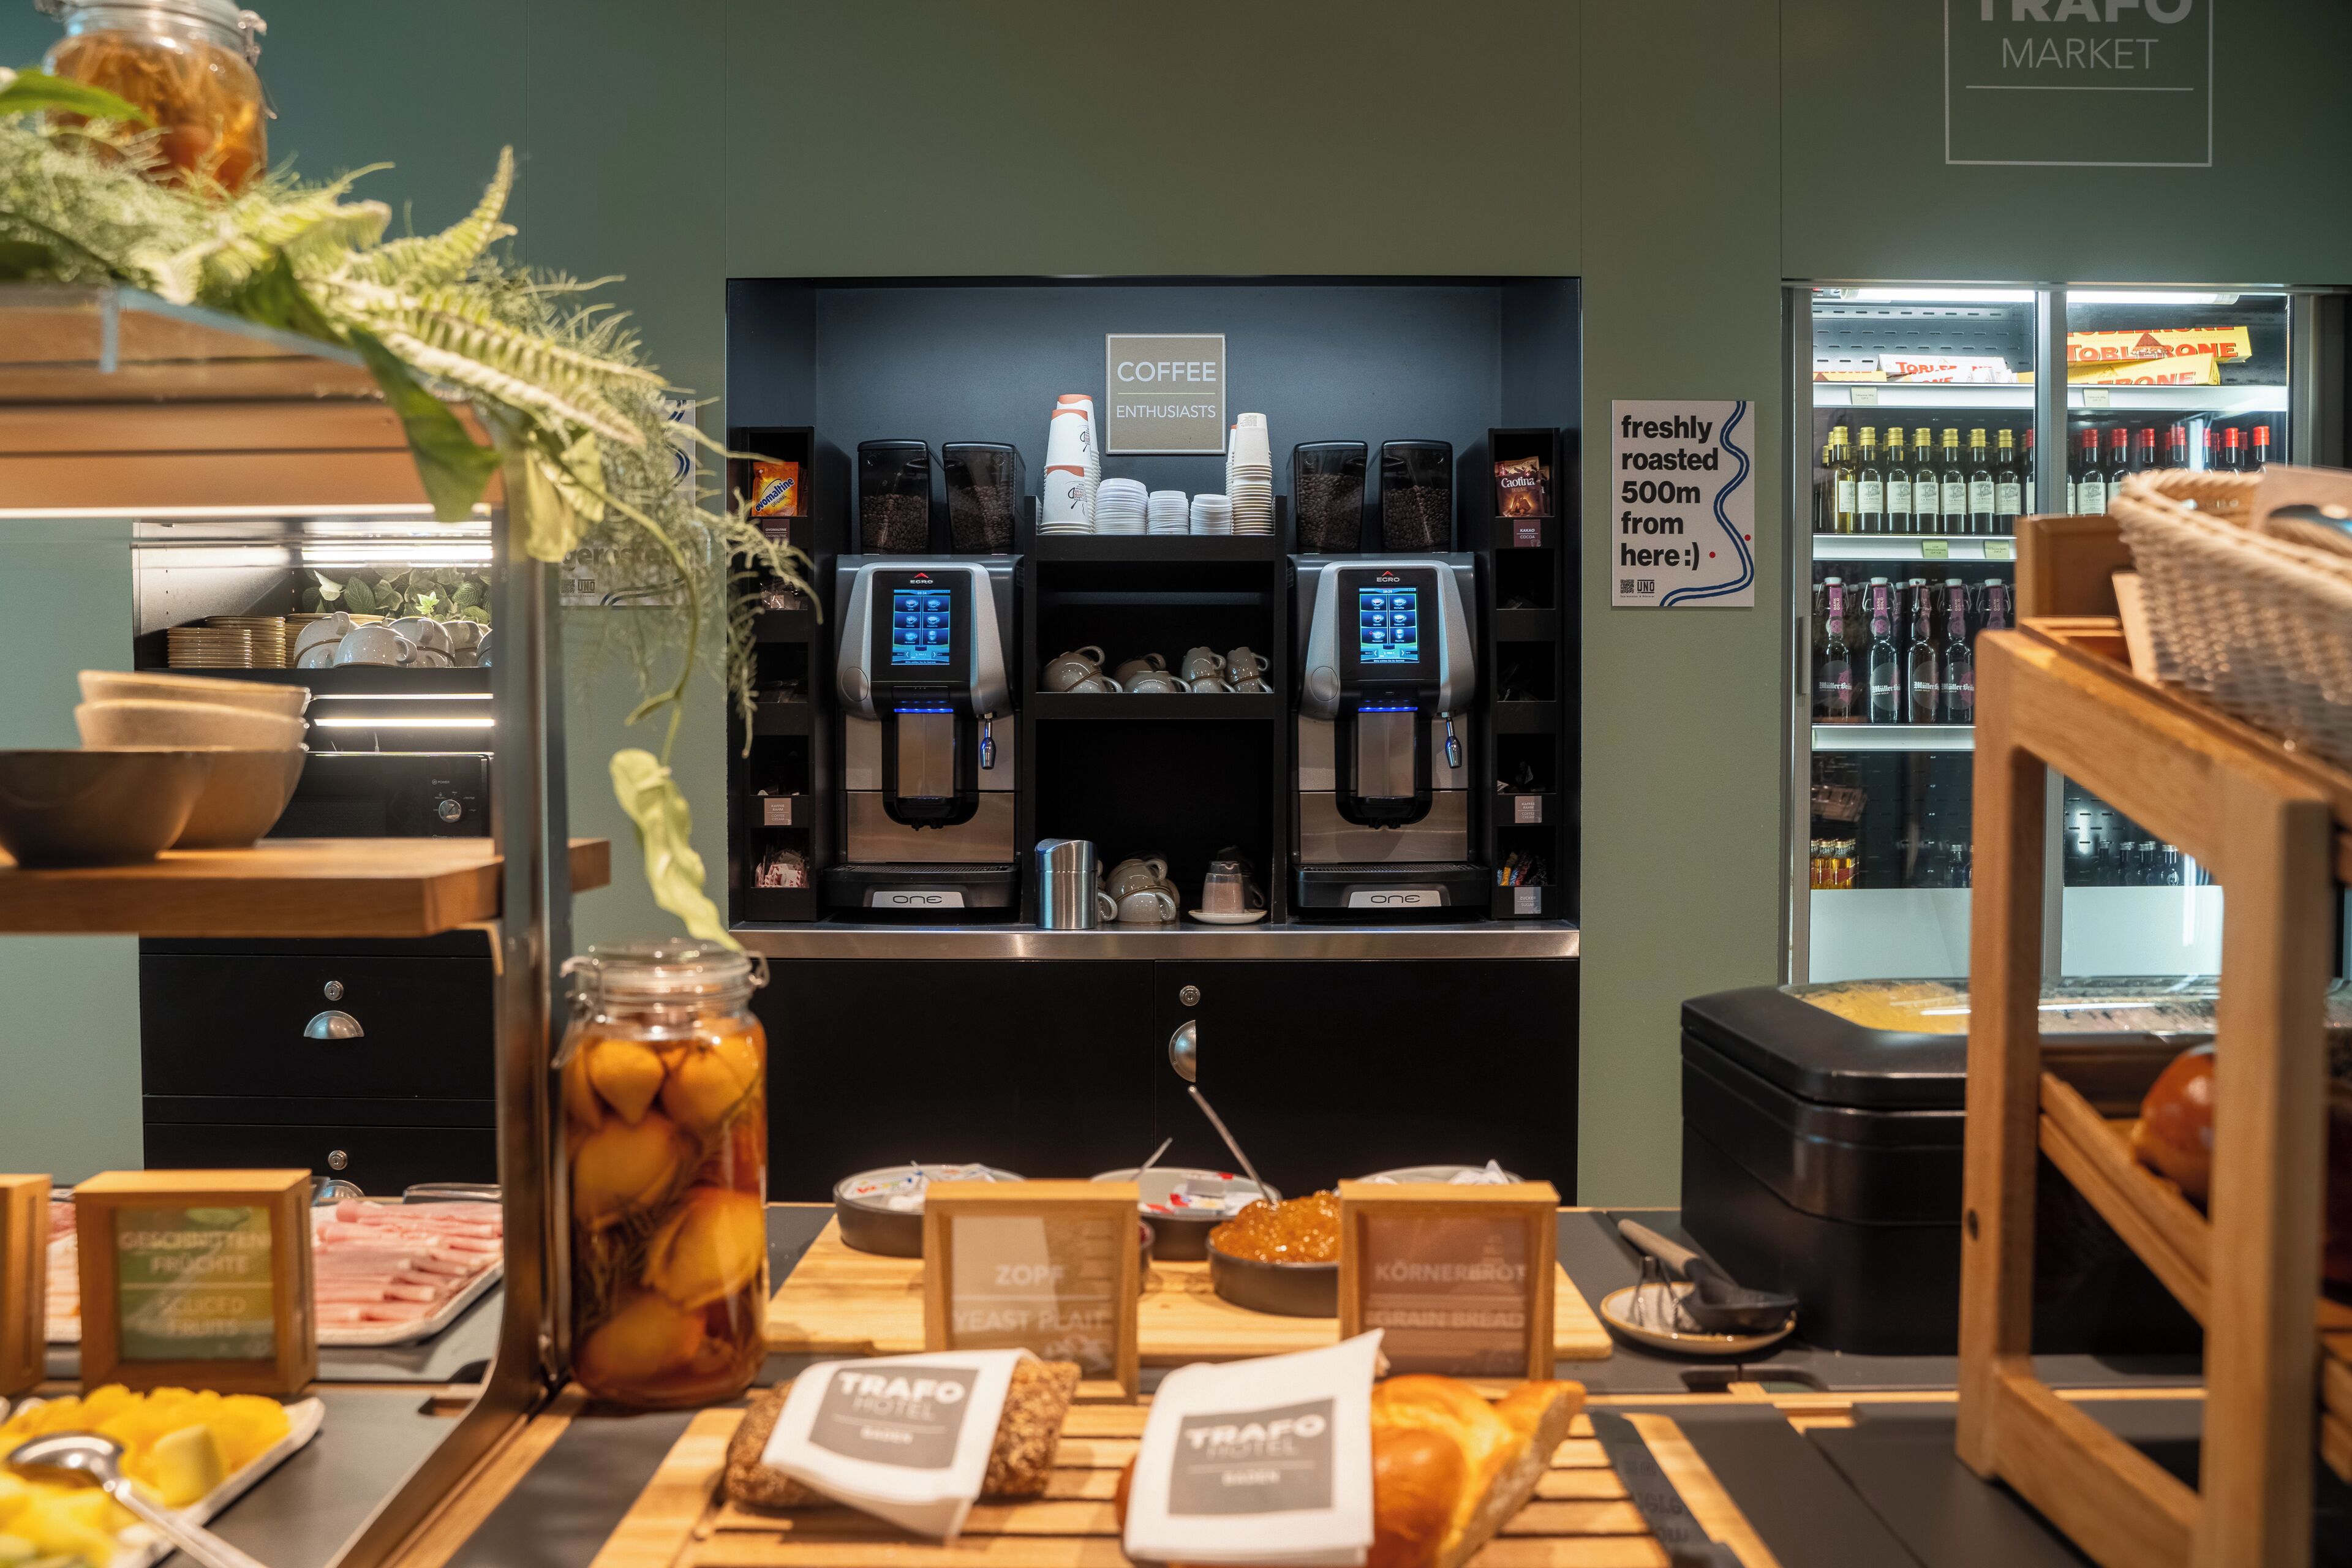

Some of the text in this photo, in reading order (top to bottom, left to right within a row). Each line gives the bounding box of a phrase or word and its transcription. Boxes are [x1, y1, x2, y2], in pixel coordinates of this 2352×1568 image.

[2002, 37, 2159, 69] MARKET
[1117, 361, 1216, 382] COFFEE
[1117, 405, 1216, 418] ENTHUSIASTS
[1621, 415, 1713, 443] freshly
[1621, 447, 1719, 471] roasted
[1501, 477, 1536, 488] Caotina
[1621, 480, 1701, 504] 500m
[771, 494, 787, 508] ORIGINAL
[1621, 511, 1684, 535] from
[578, 581, 595, 592] UNO
[1637, 581, 1655, 592] UNO
[994, 1264, 1066, 1286] ZOPF
[1374, 1259, 1526, 1282] KÖRNERBROT
[953, 1309, 1105, 1332] YEAST PLAIT
[1377, 1311, 1524, 1327] GRAIN BREAD
[839, 1371, 965, 1405] TRAFO
[852, 1397, 936, 1421] HOTEL
[1185, 1414, 1327, 1449] TRAFO
[1206, 1437, 1298, 1460] HOTEL
